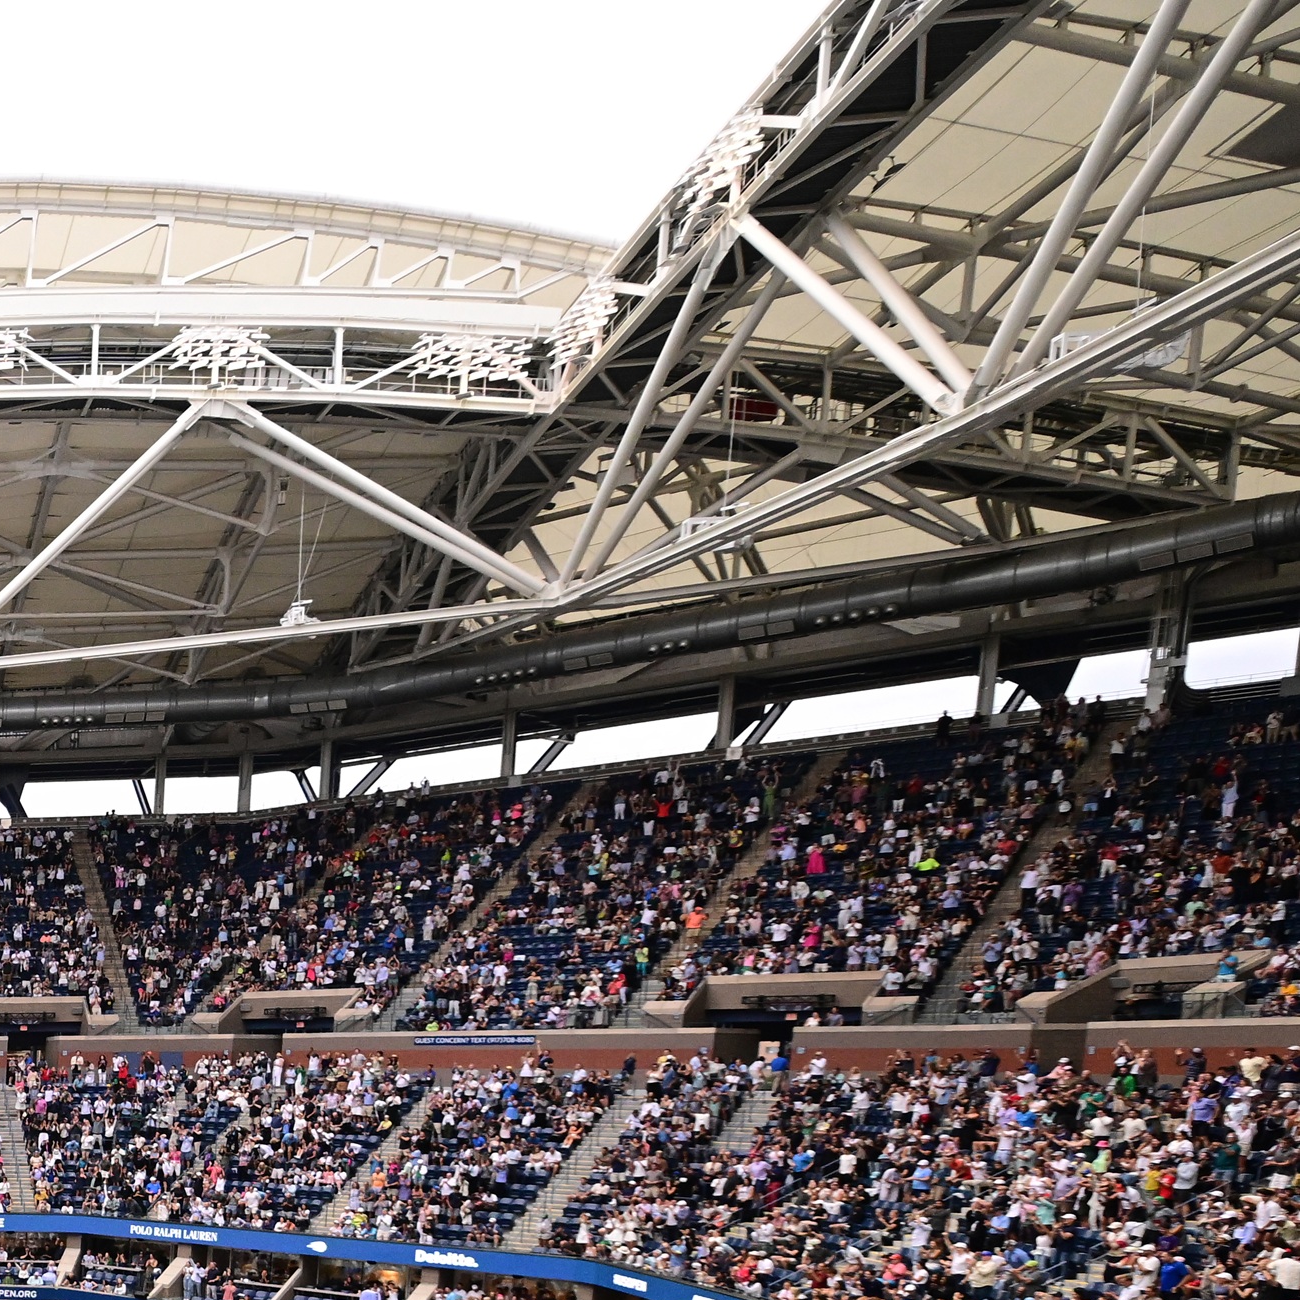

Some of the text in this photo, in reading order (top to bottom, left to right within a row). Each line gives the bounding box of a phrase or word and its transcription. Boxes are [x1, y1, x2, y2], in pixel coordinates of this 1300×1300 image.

[130, 1224, 218, 1242] POLO RALPH LAUREN
